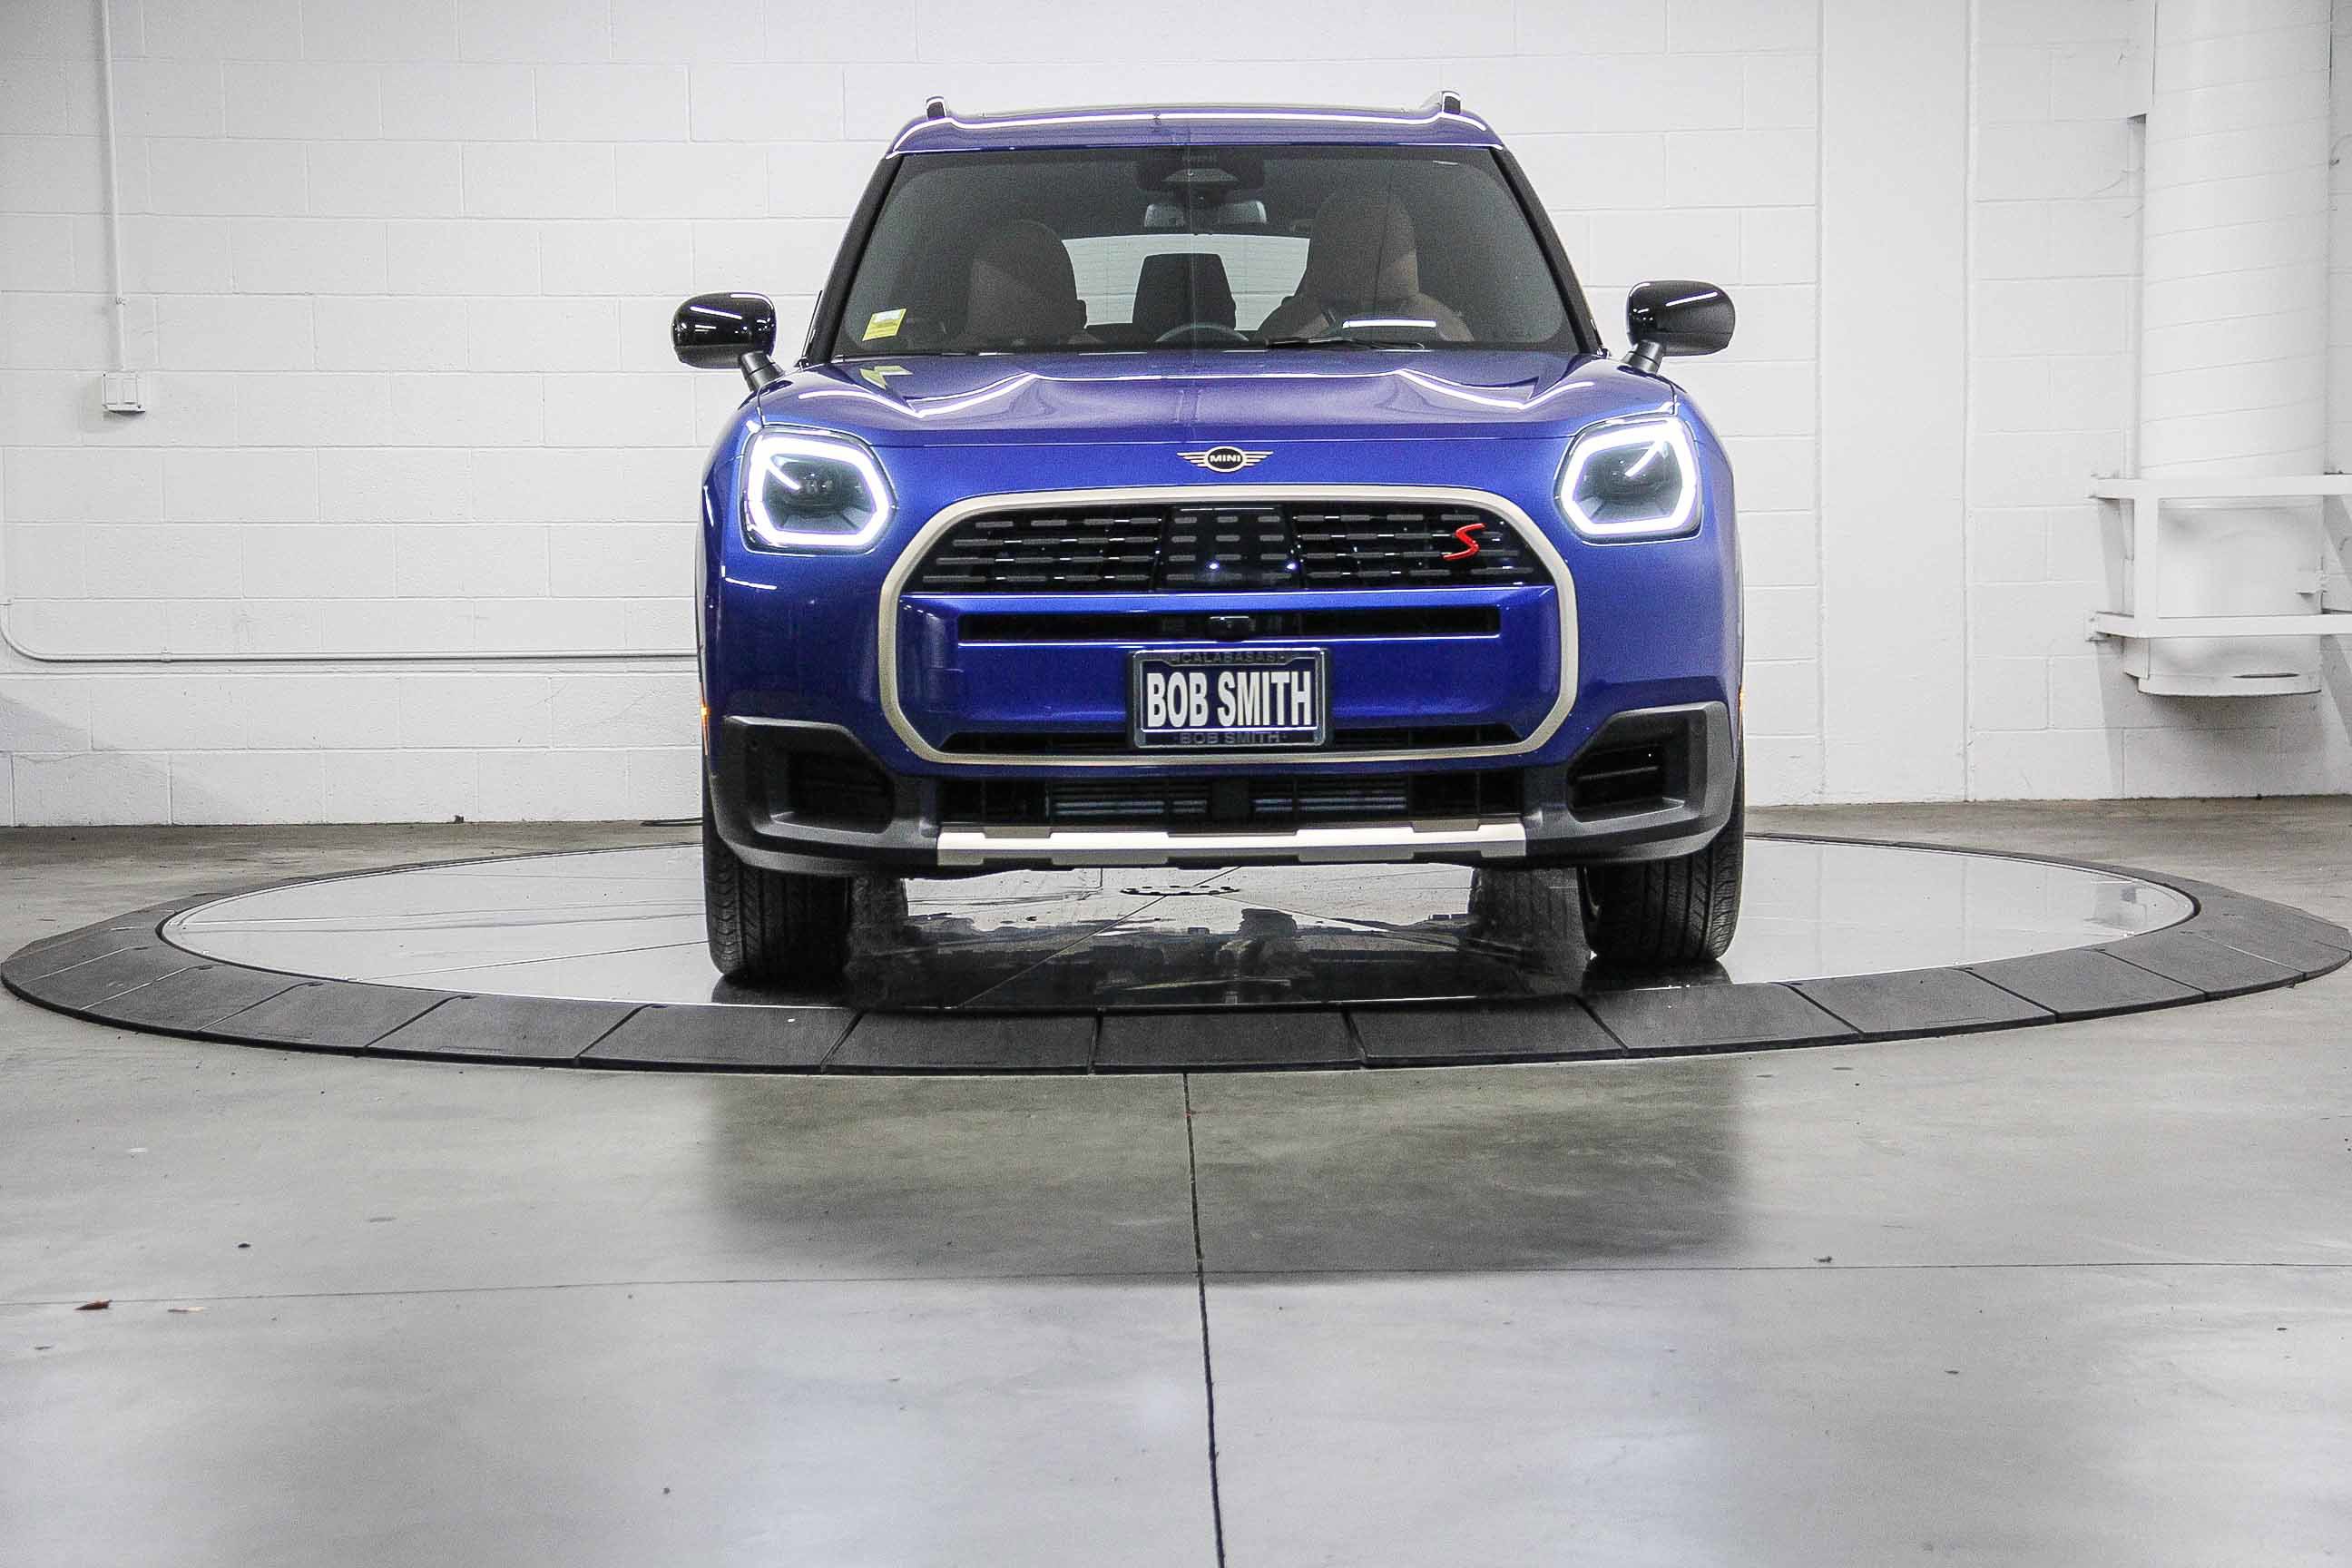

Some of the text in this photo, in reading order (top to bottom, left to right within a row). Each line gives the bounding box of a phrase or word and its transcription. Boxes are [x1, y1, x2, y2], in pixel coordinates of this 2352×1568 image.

[1209, 454, 1242, 463] MINI
[1442, 523, 1485, 561] S
[1146, 671, 1312, 728] BOB SMITH
[1181, 731, 1280, 744] BOB SMITH
